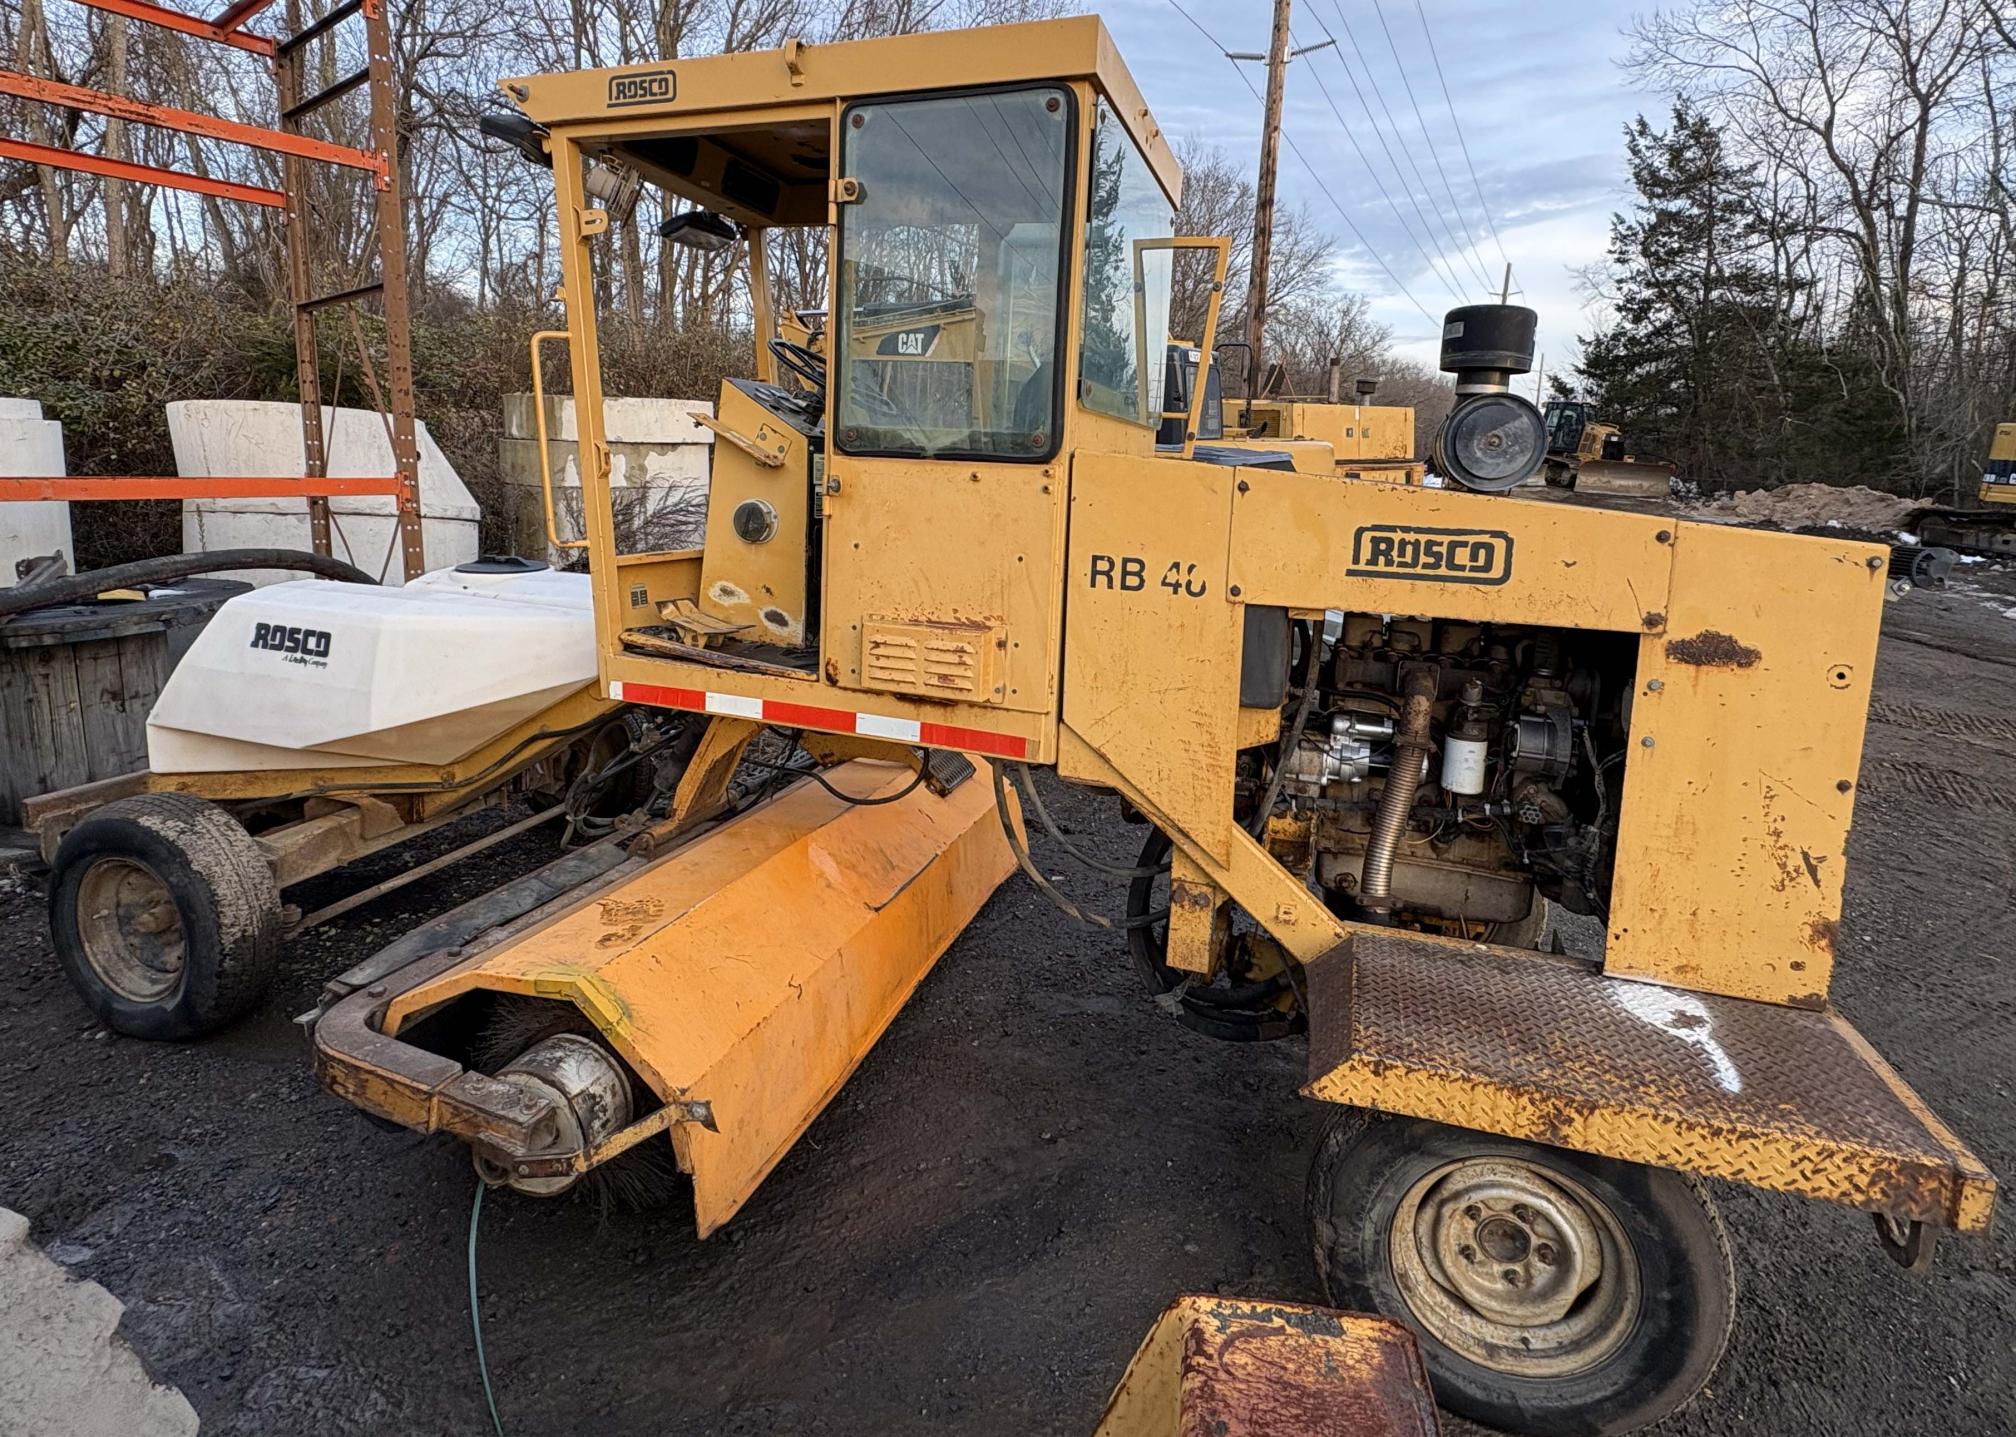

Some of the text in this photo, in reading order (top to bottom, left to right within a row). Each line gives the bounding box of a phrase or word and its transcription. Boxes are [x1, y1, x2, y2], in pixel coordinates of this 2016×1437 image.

[614, 77, 669, 101] ROSCO
[898, 333, 925, 355] CAT
[1365, 535, 1495, 574] ROSCO
[1090, 554, 1146, 592] RB
[250, 622, 332, 658] ROSCO
